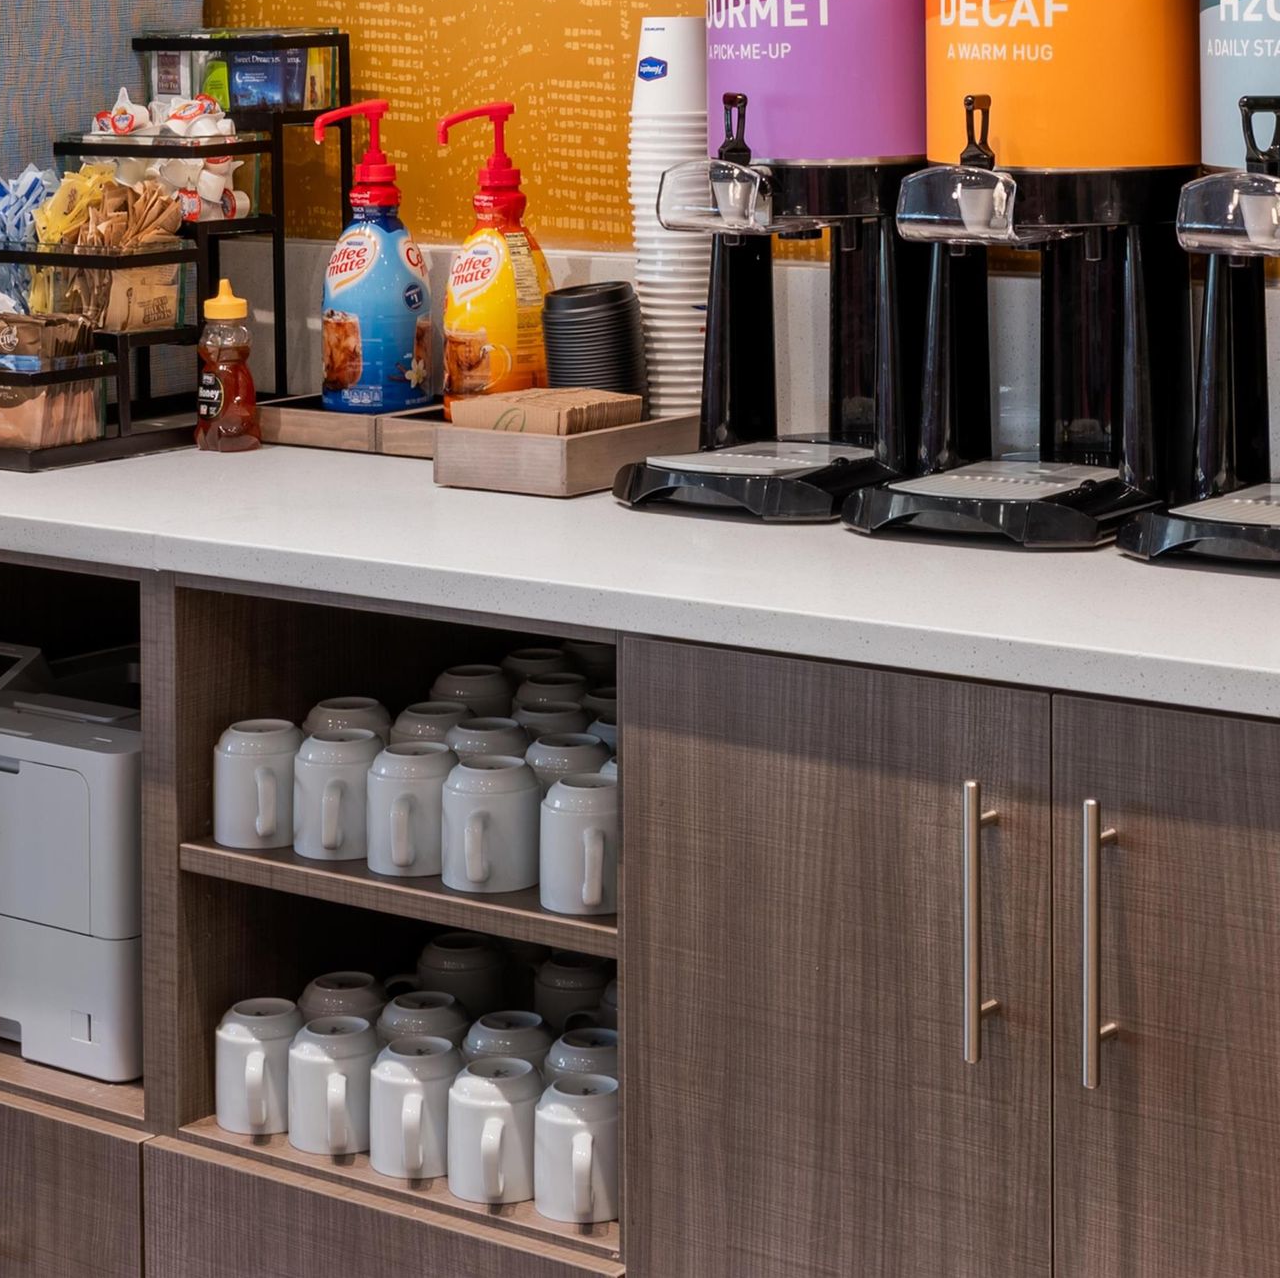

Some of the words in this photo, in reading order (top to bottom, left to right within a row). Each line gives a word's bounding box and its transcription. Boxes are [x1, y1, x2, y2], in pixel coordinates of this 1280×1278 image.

[714, 43, 791, 59] PICK-ME-UP
[947, 43, 956, 60] A
[958, 43, 1007, 60] WARM
[1013, 45, 1052, 60] HUG
[1207, 38, 1214, 57] A
[1215, 39, 1249, 56] DAILY
[328, 258, 366, 277] mate
[453, 268, 490, 287] mate
